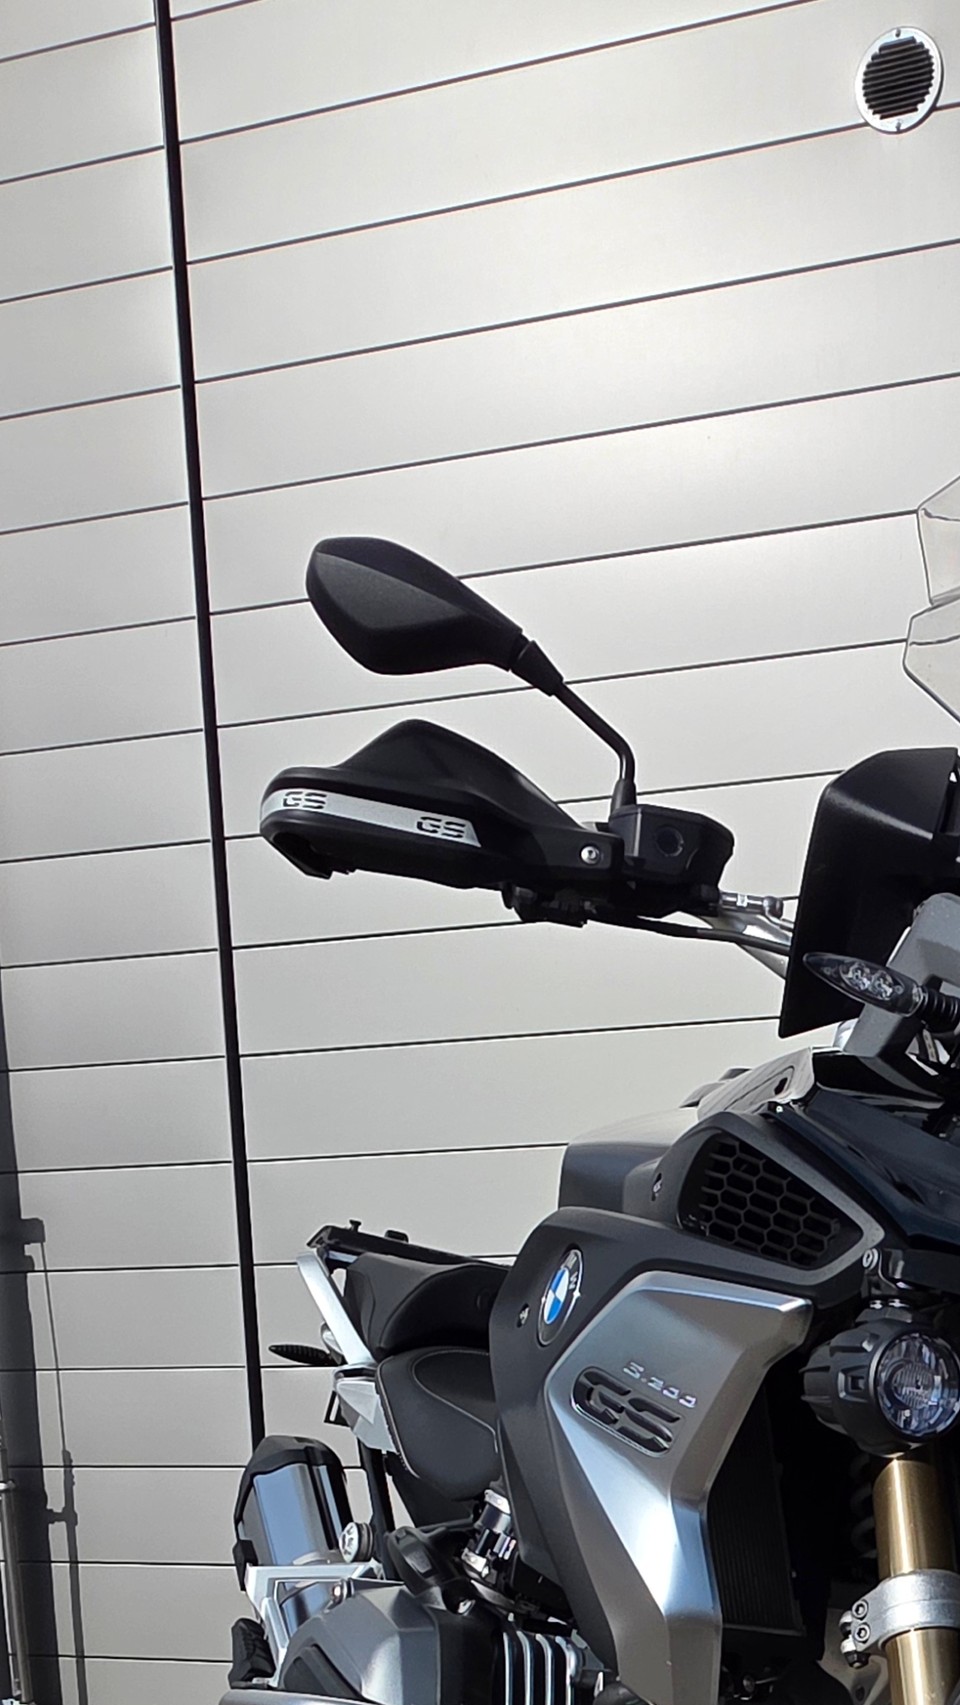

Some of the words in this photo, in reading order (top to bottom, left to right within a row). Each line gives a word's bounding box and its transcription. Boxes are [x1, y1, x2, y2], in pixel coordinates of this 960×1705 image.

[282, 791, 328, 810] GS
[416, 816, 466, 839] GS
[571, 1366, 681, 1455] GS
